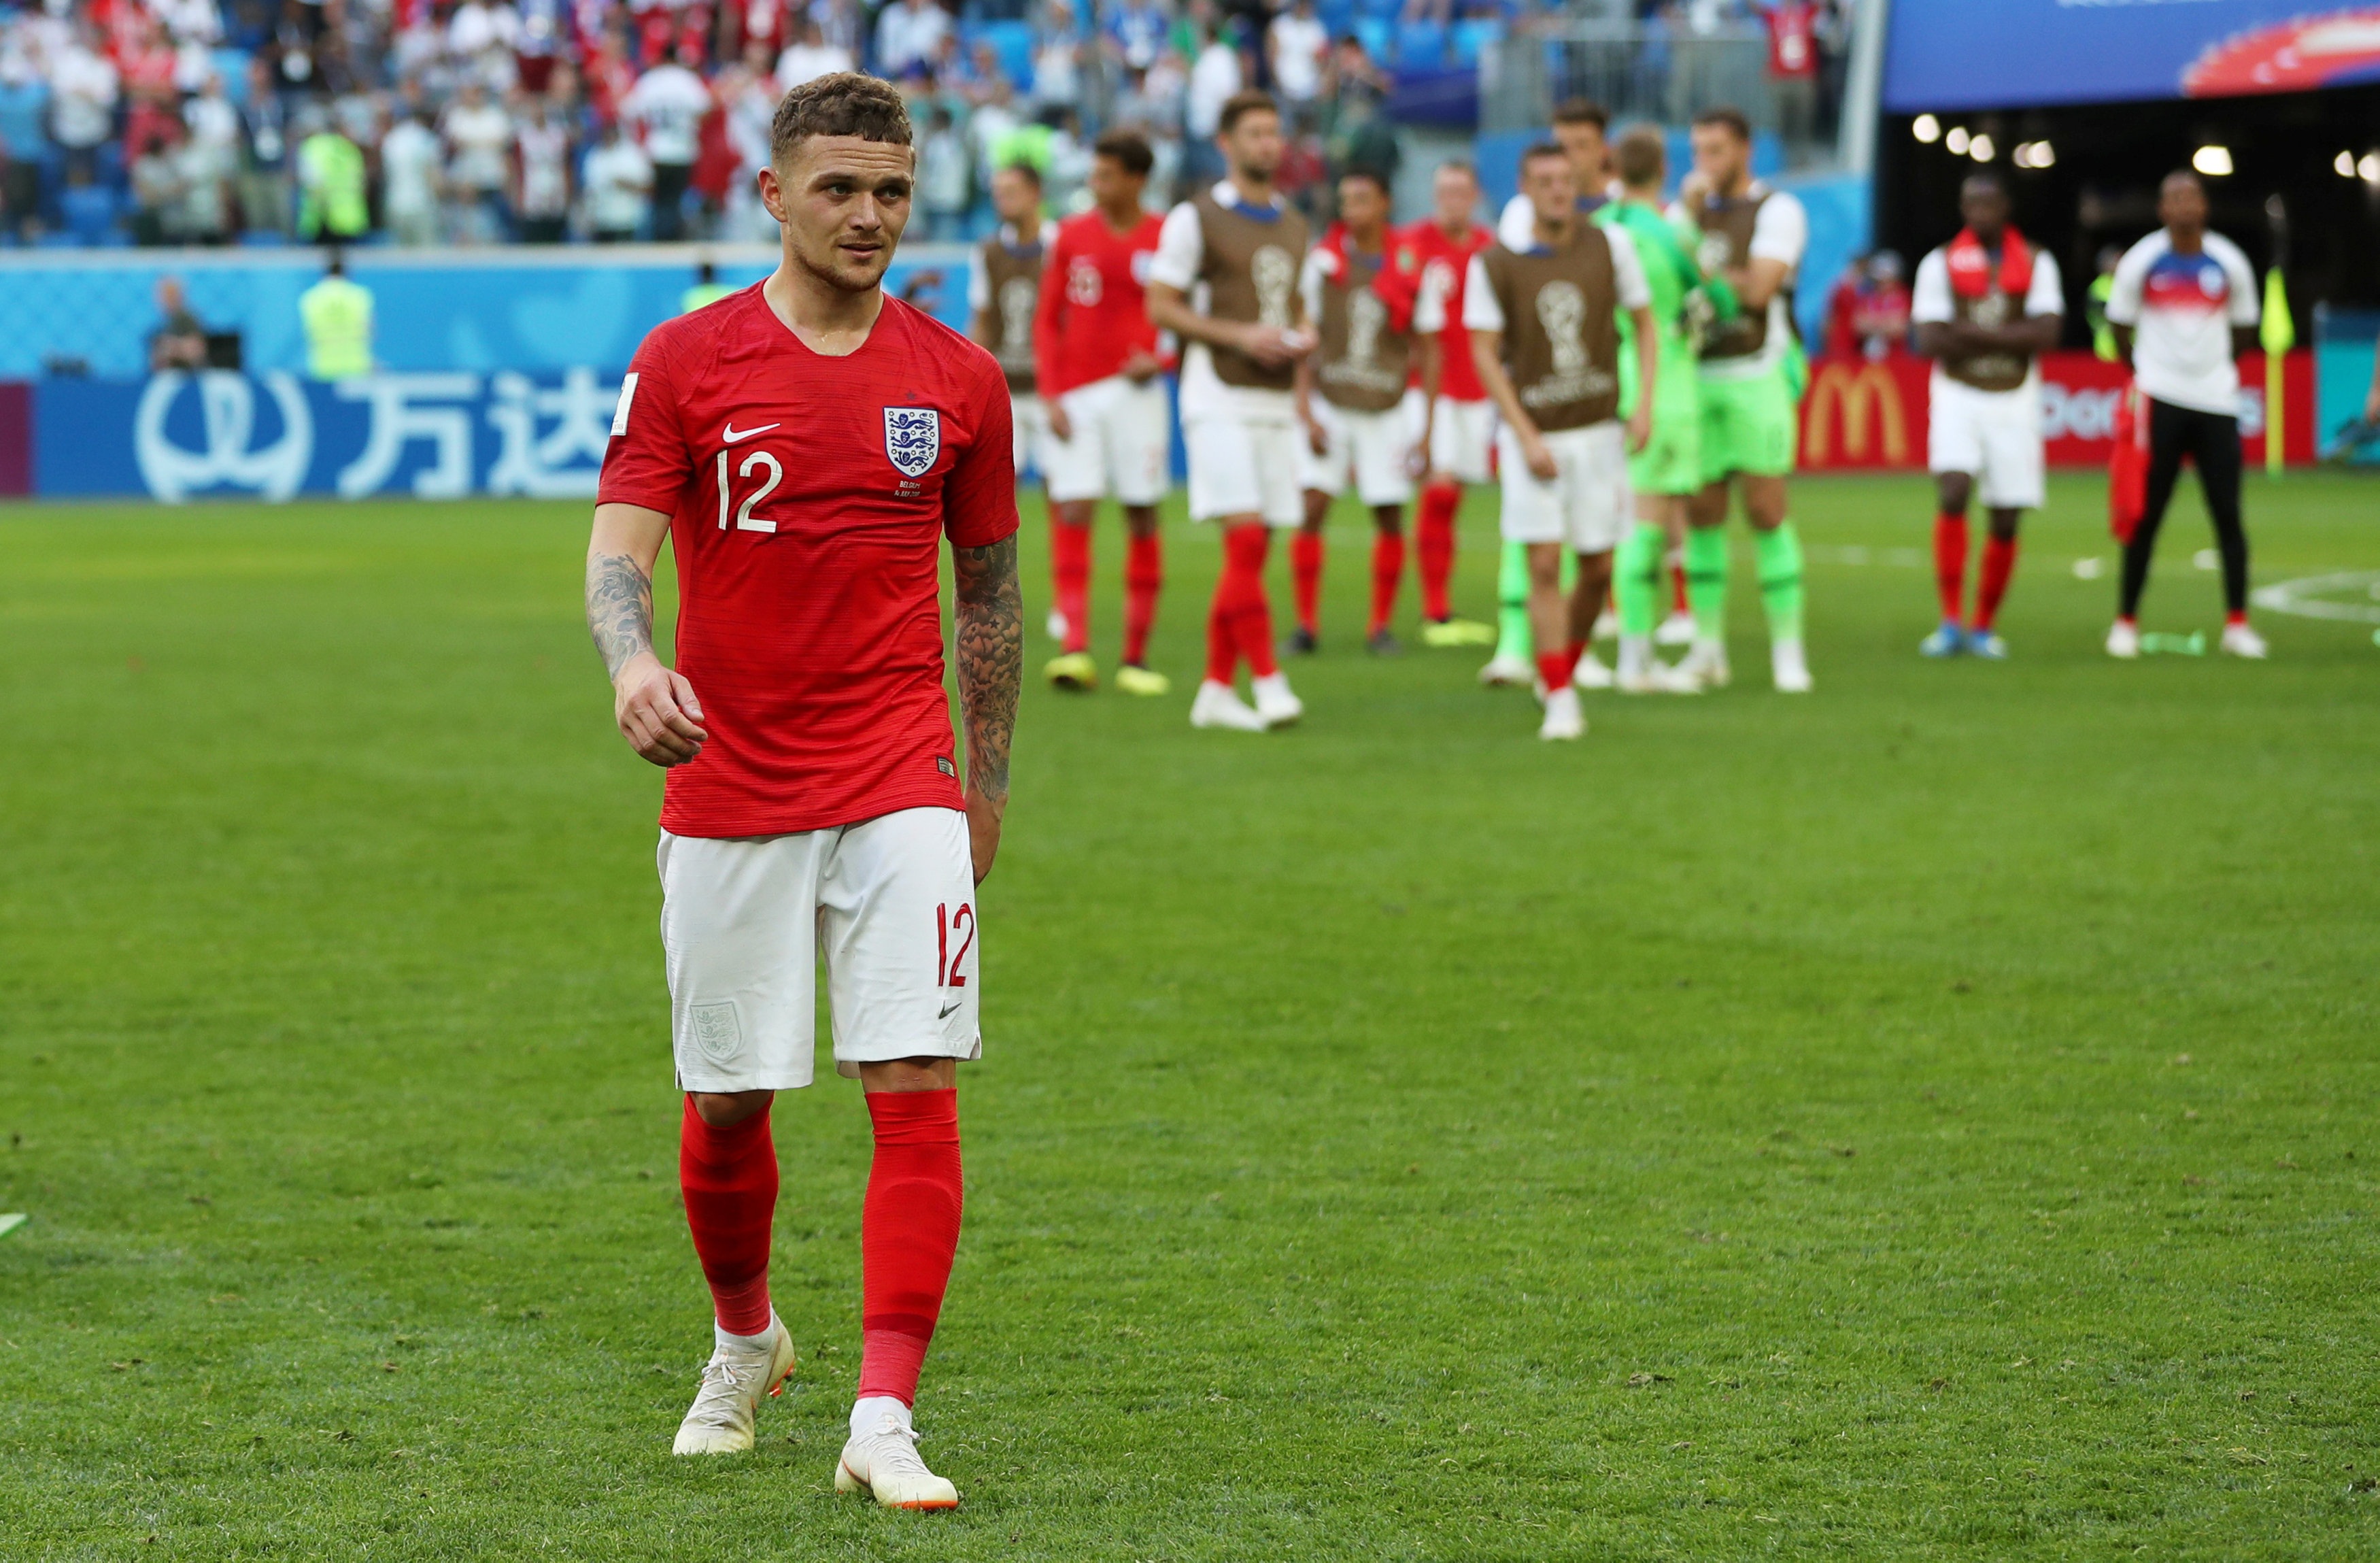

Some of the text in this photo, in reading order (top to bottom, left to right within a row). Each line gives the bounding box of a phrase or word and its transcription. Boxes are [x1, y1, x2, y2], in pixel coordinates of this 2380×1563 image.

[335, 367, 621, 499] 万达
[717, 450, 783, 533] 12
[936, 903, 974, 986] 12
